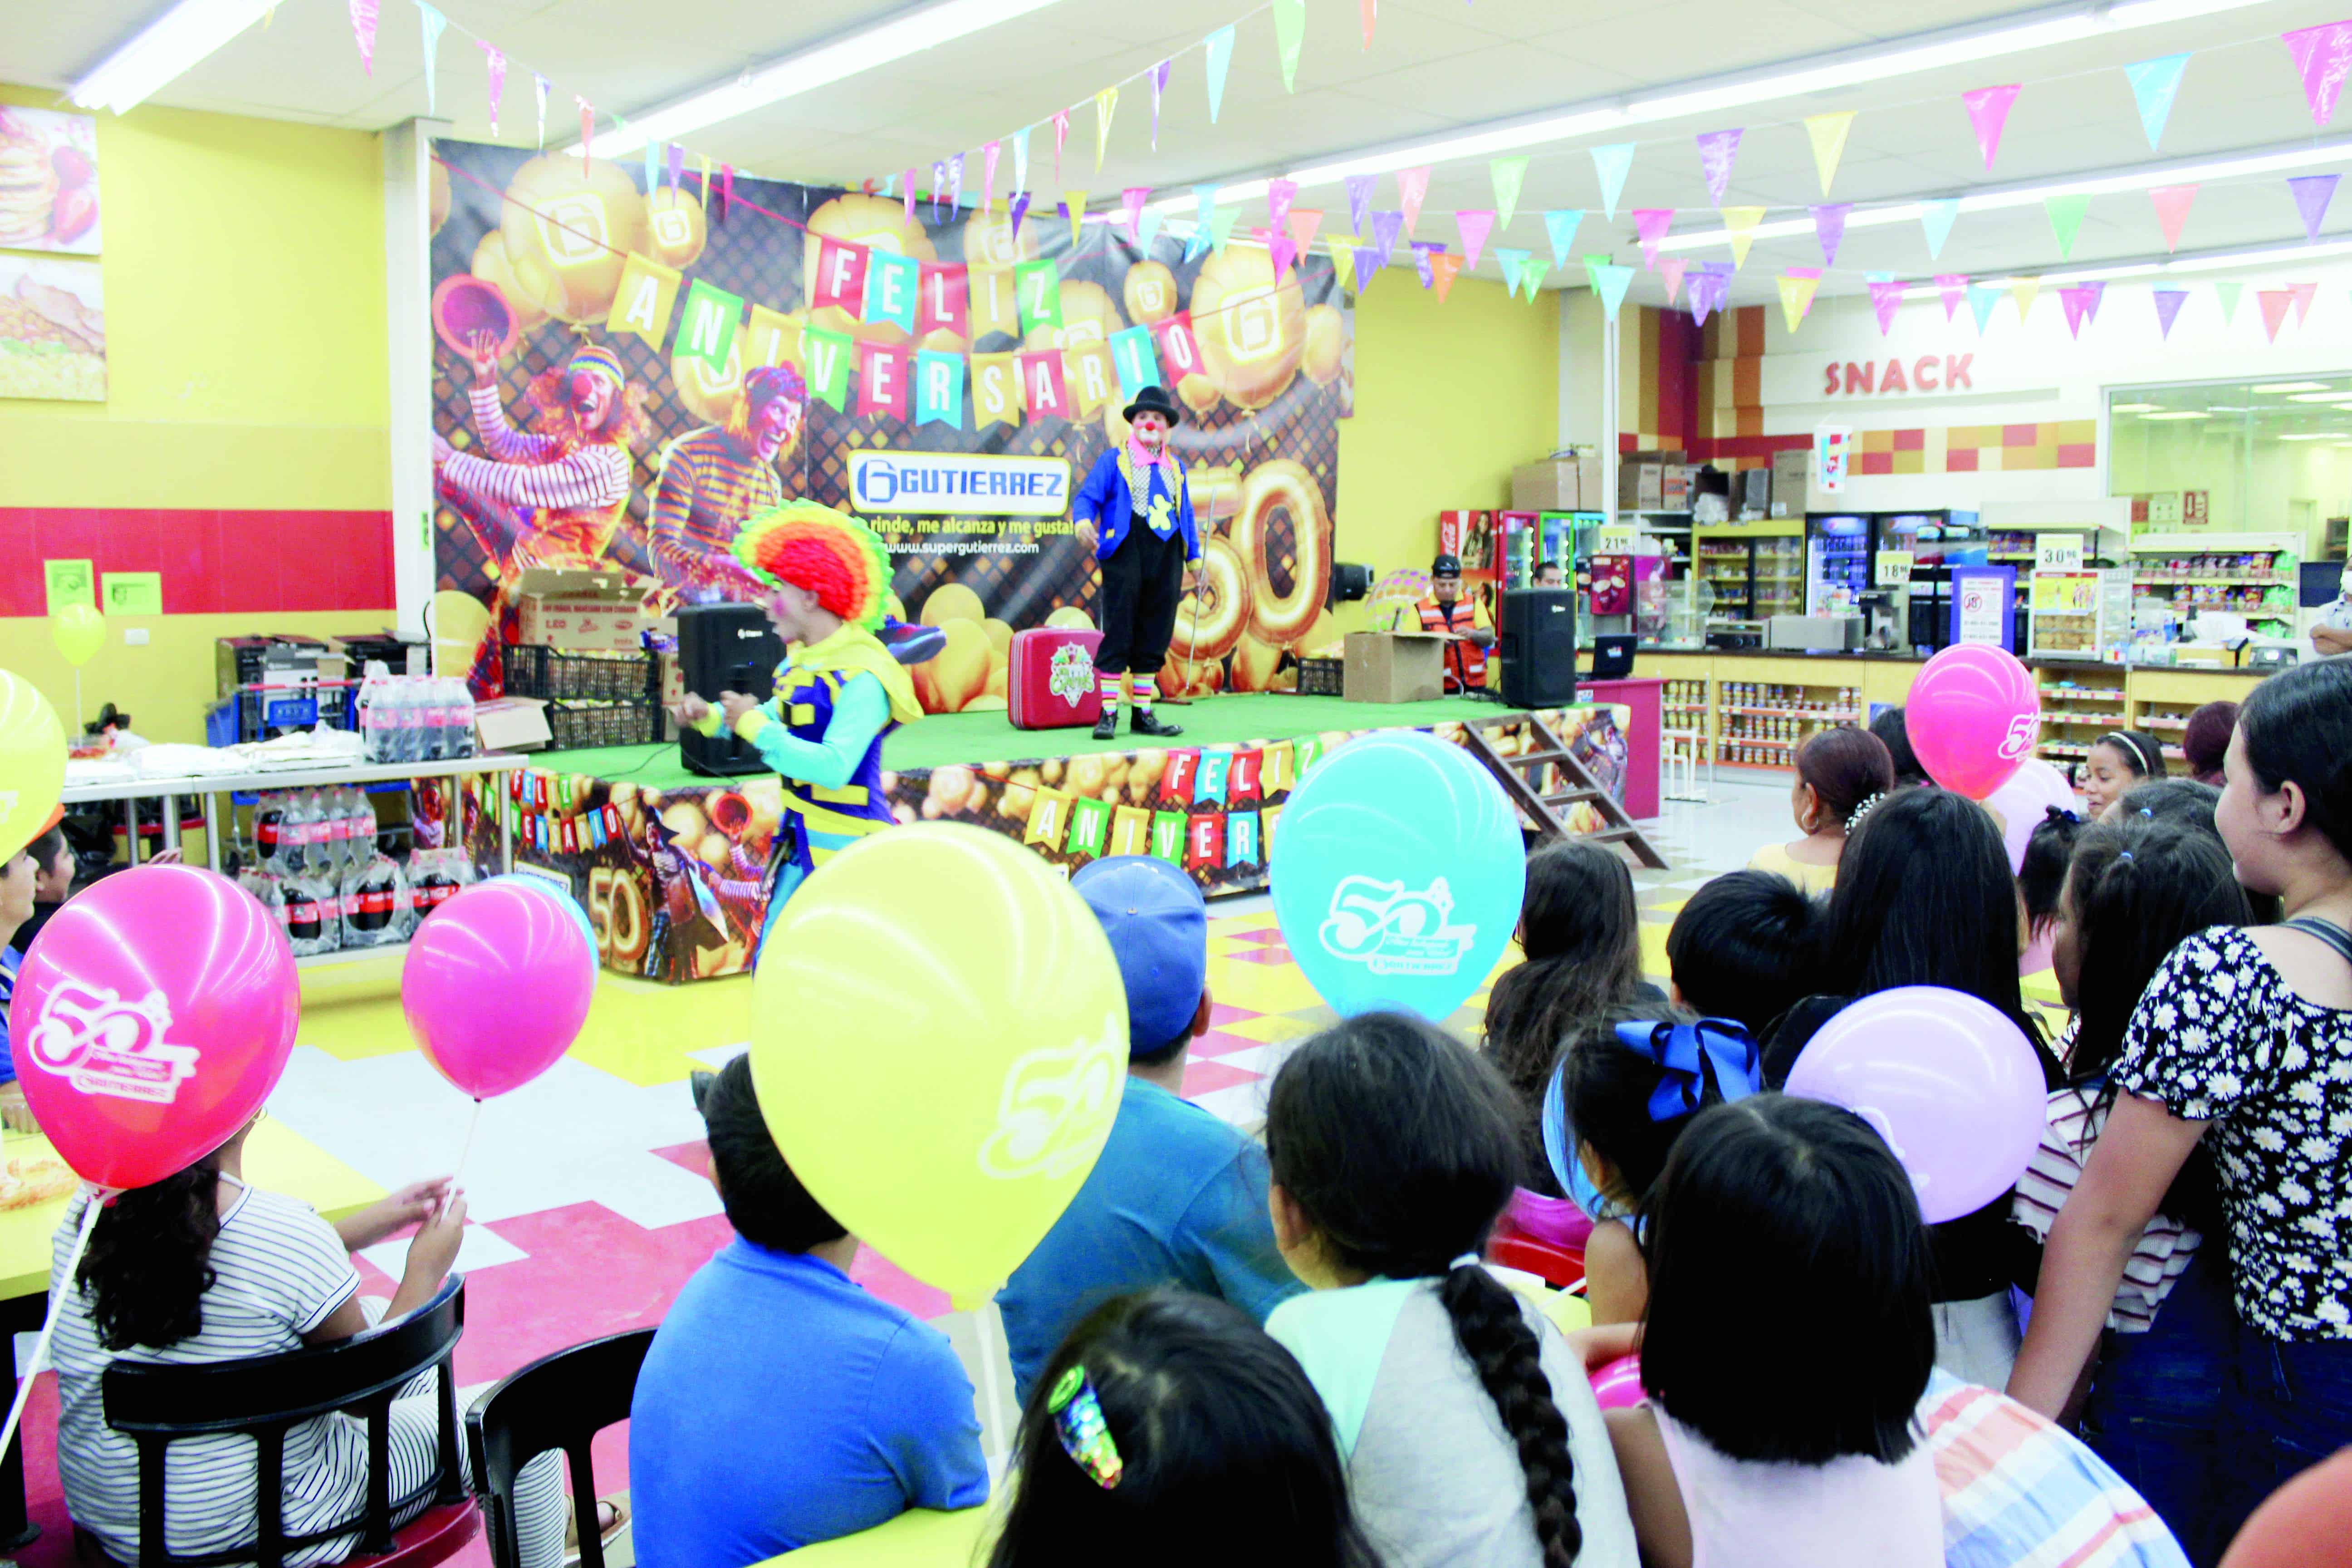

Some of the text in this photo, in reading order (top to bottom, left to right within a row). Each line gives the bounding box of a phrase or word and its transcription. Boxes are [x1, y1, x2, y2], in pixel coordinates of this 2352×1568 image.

[830, 247, 1052, 322] FELIZ
[625, 275, 1193, 413] ANIVERSARIO
[1824, 353, 1975, 395] SNACK
[900, 467, 1063, 497] GUTIERREZ
[870, 515, 1074, 538] rinde, me alcanza y me gusta!
[885, 541, 1039, 556] www.supergutierrez.com
[1884, 565, 1898, 578] 18
[2045, 549, 2063, 563] 30
[514, 770, 570, 804] FELIZ
[1171, 741, 1314, 793] FELIZ
[1035, 800, 1280, 858] ANIVER
[589, 867, 649, 961] 50
[1318, 874, 1446, 961] 50
[28, 980, 160, 1076] 50
